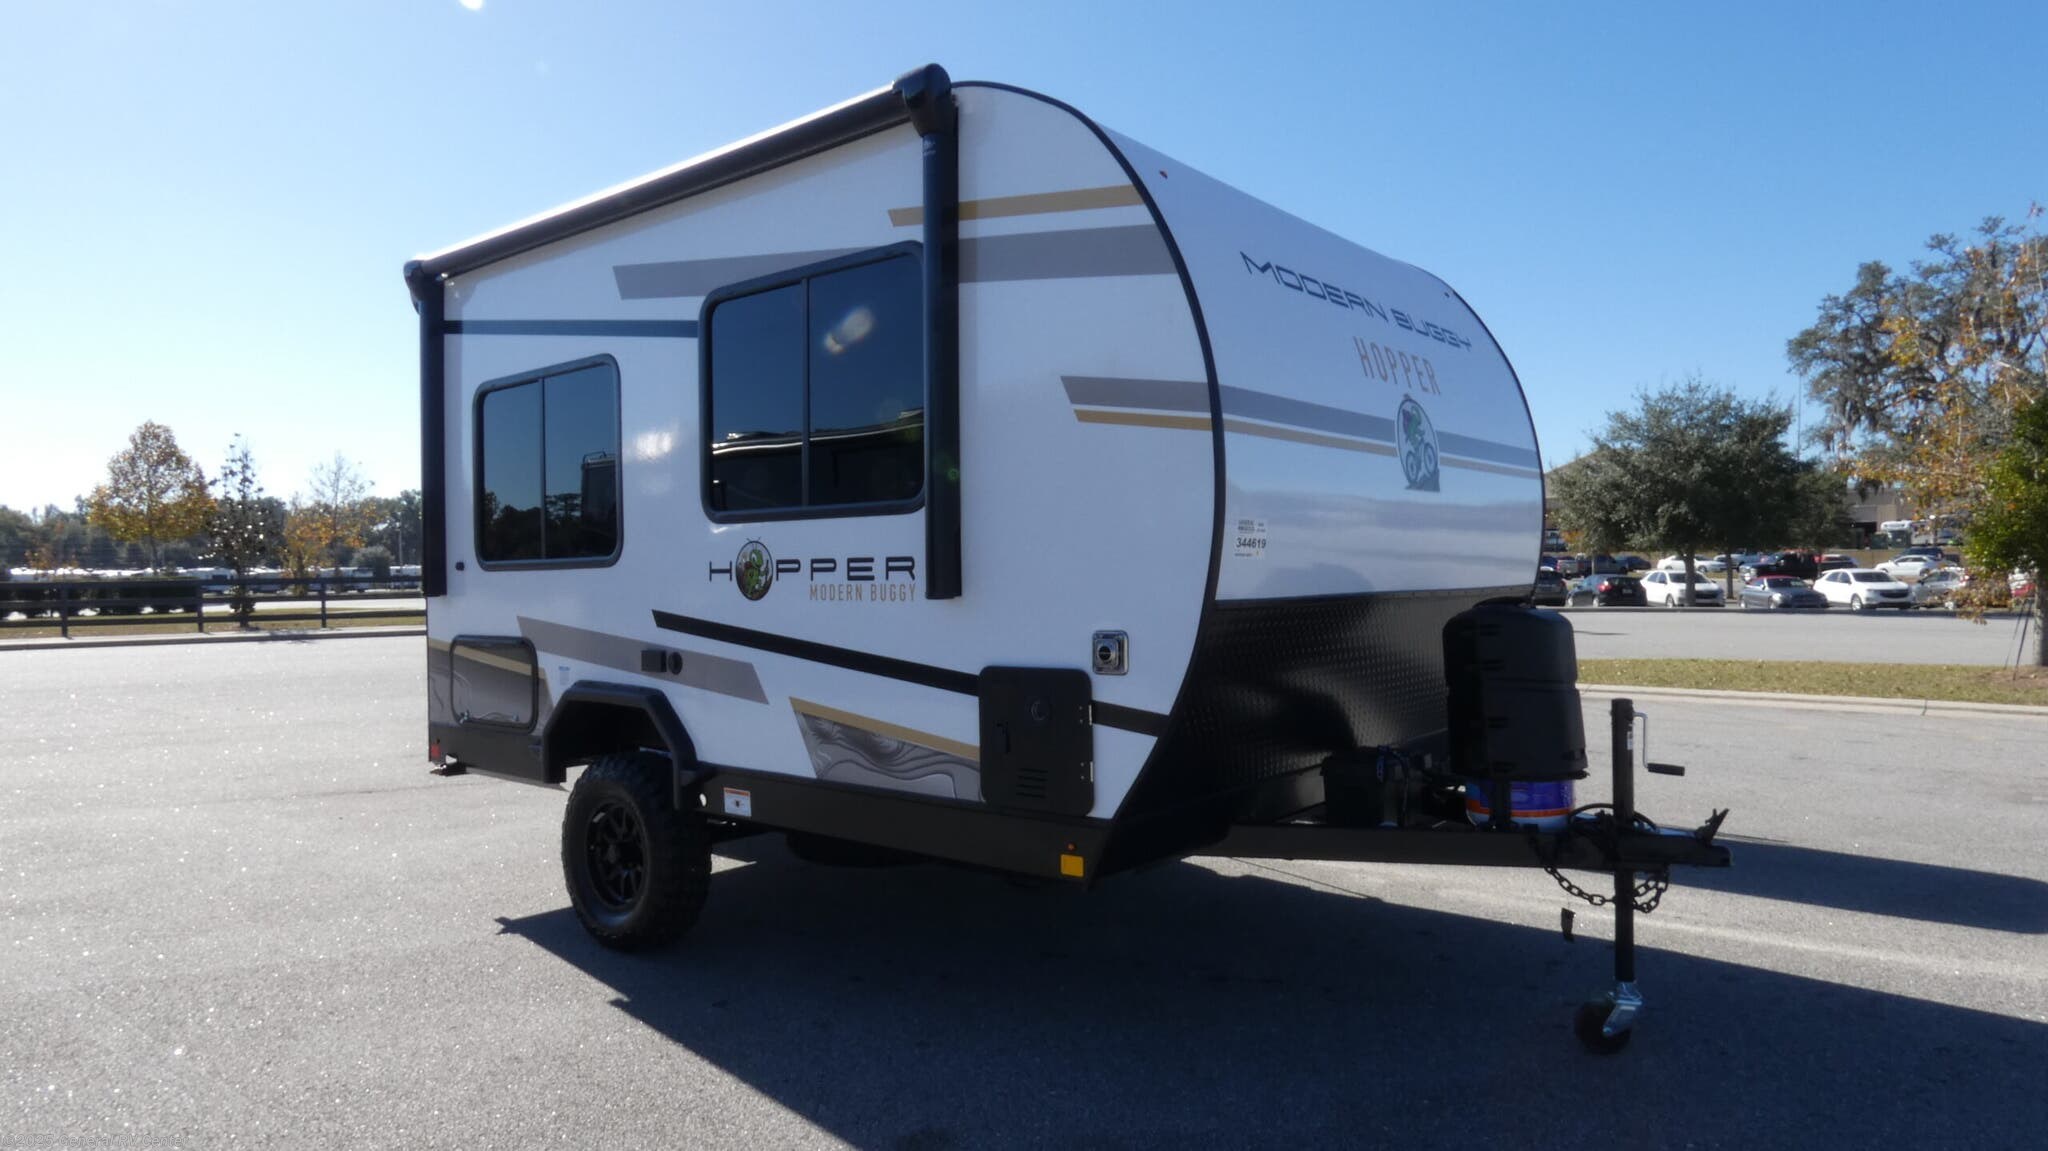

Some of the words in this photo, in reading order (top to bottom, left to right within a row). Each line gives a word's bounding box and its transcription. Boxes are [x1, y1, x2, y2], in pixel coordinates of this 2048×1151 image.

[1240, 250, 1389, 322] MODERN
[1390, 307, 1472, 351] BUGGY
[1353, 335, 1441, 396] HOPPER
[809, 583, 863, 601] MODERN
[870, 583, 917, 601] BUGGY
